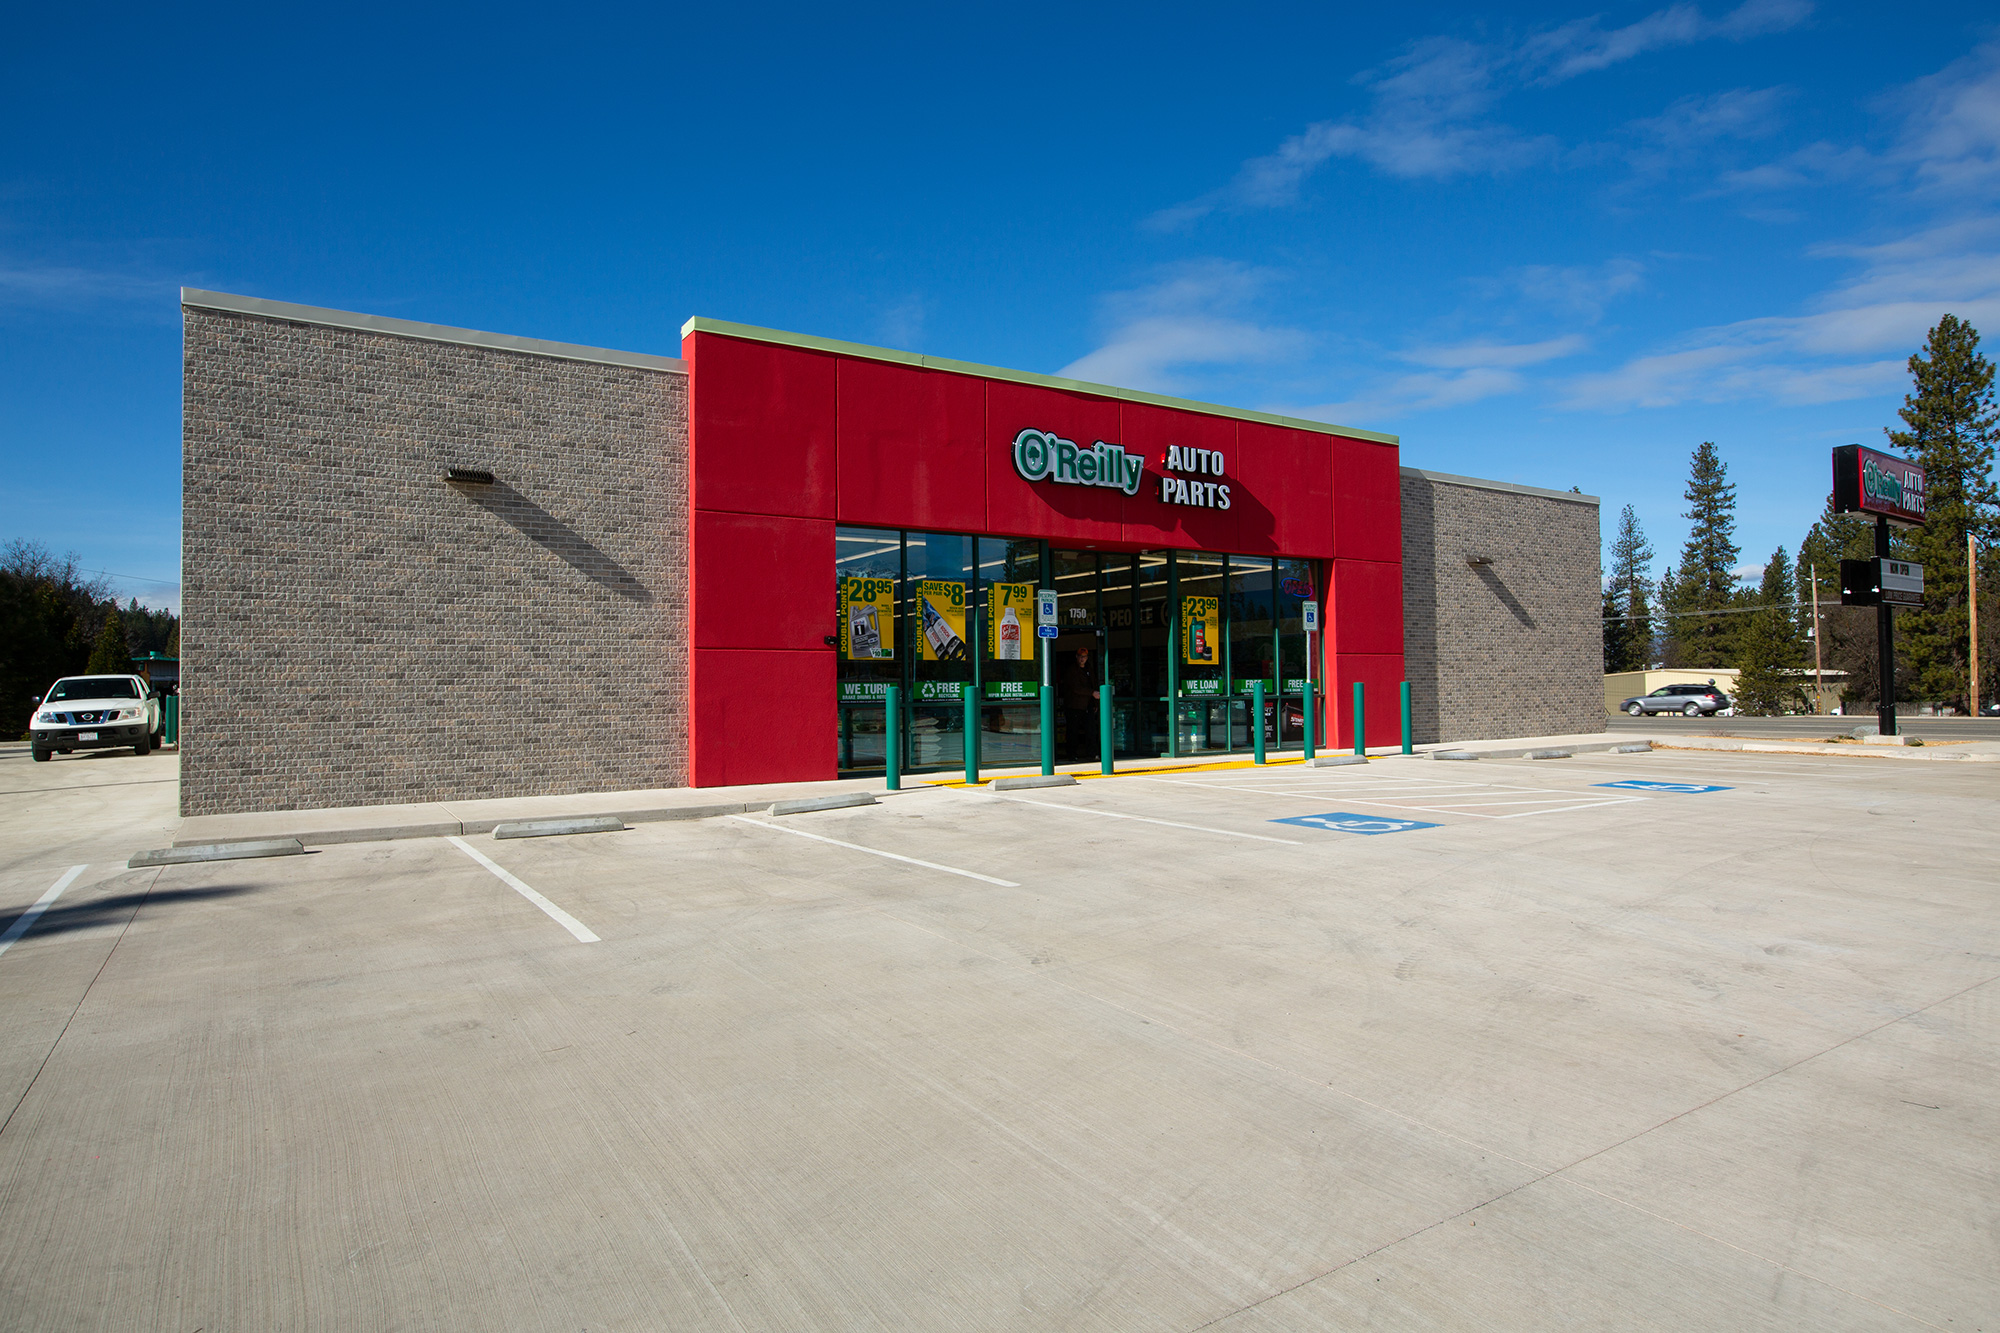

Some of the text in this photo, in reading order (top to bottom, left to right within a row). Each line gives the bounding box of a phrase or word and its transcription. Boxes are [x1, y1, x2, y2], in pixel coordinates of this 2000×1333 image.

[1018, 432, 1142, 492] O'Reilly
[1167, 445, 1225, 476] AUTO
[1903, 471, 1923, 492] AUTO
[1162, 477, 1231, 510] PARTS
[1902, 491, 1925, 514] PARTS
[924, 582, 964, 606] SAVE $8
[1284, 580, 1309, 595] OPEN
[1069, 608, 1087, 619] 1750
[857, 625, 862, 635] 1
[844, 683, 864, 695] WE
[936, 682, 960, 693] FREE
[1001, 682, 1023, 692] FREE
[1186, 680, 1219, 690] WE LOAN
[1288, 680, 1304, 688] FREE
